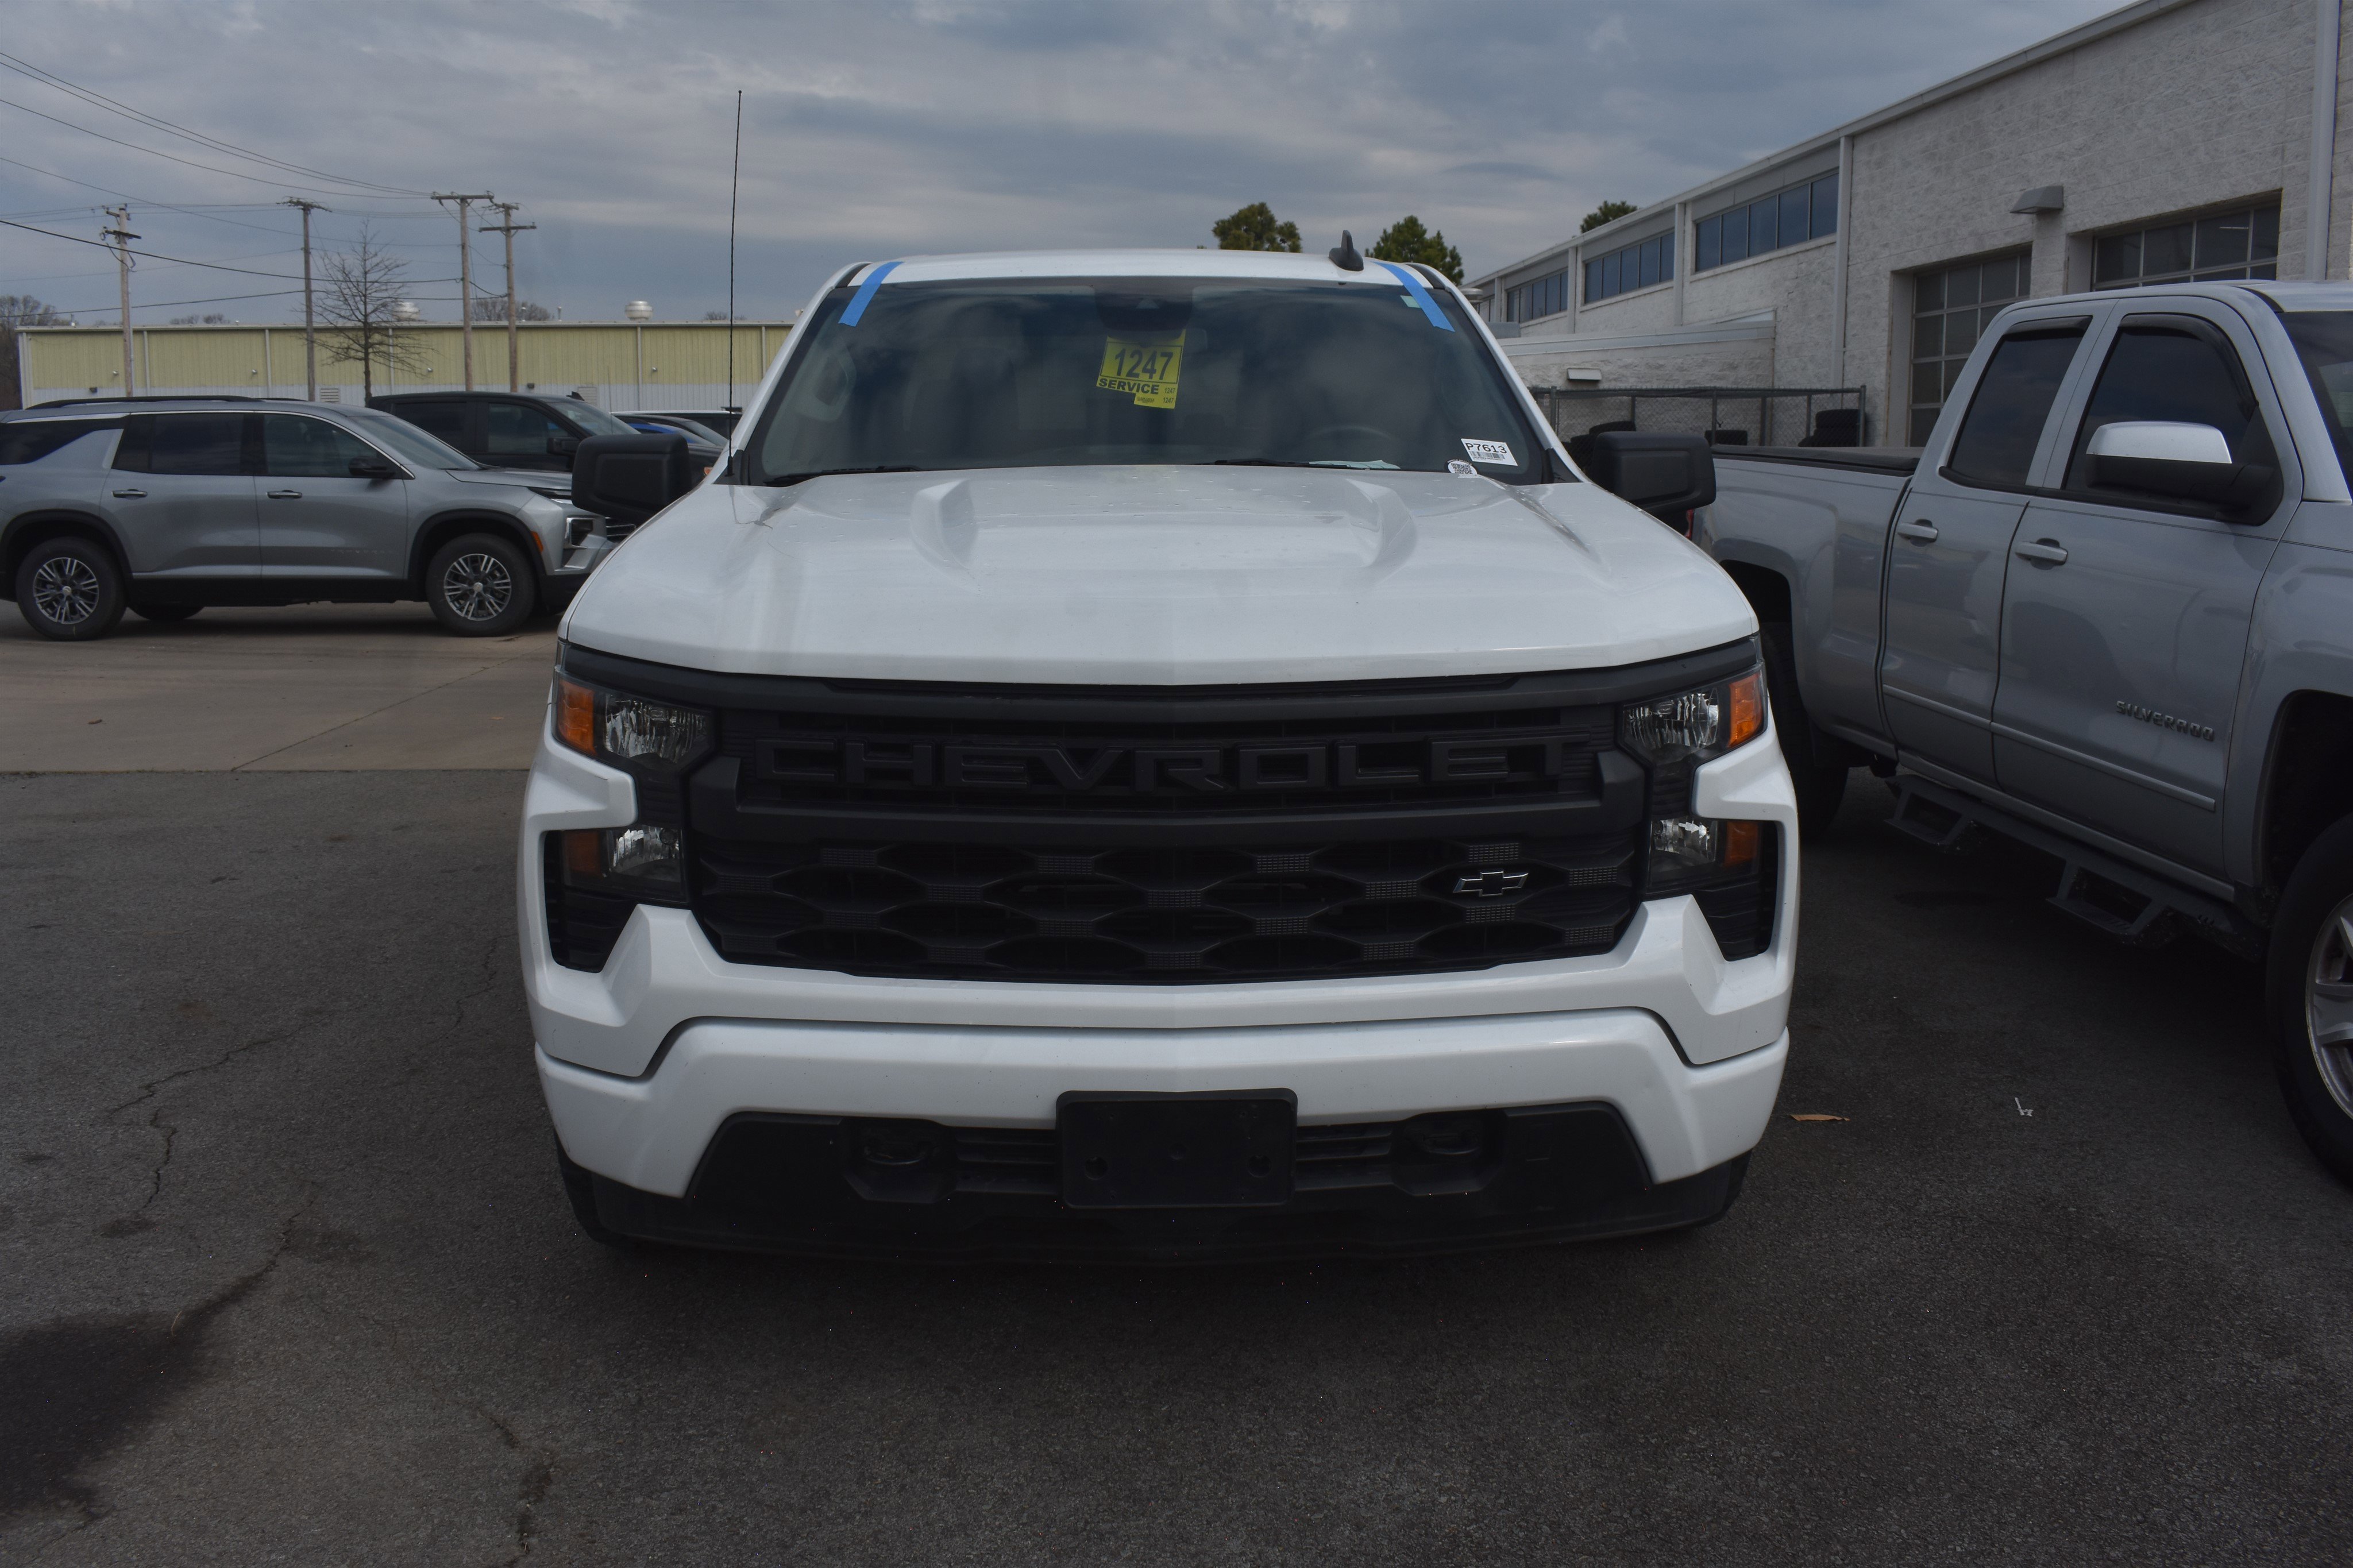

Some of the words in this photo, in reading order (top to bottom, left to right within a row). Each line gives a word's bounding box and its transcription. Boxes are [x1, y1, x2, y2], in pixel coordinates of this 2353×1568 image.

[1114, 347, 1174, 380] 1247
[1098, 377, 1160, 395] SERVICE
[1465, 442, 1507, 454] P7613
[2116, 700, 2215, 741] SILVERADO
[753, 729, 1591, 794] CHEVROLET
